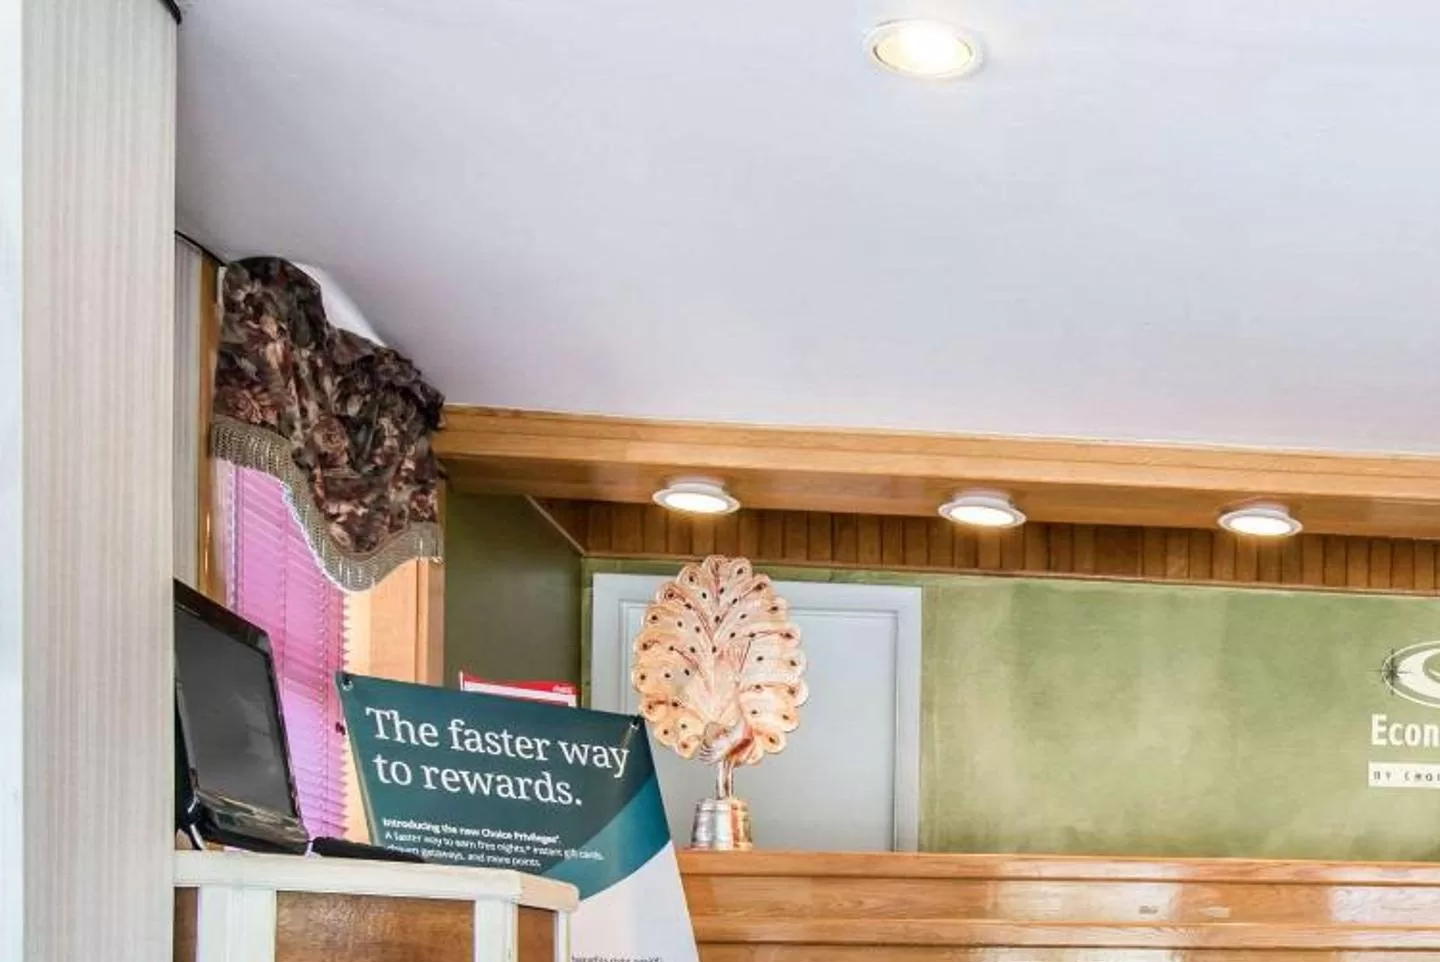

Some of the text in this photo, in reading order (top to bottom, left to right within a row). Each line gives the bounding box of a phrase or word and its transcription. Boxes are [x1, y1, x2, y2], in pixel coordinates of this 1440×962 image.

[364, 705, 630, 779] The faster way
[371, 753, 583, 807] to rewards.
